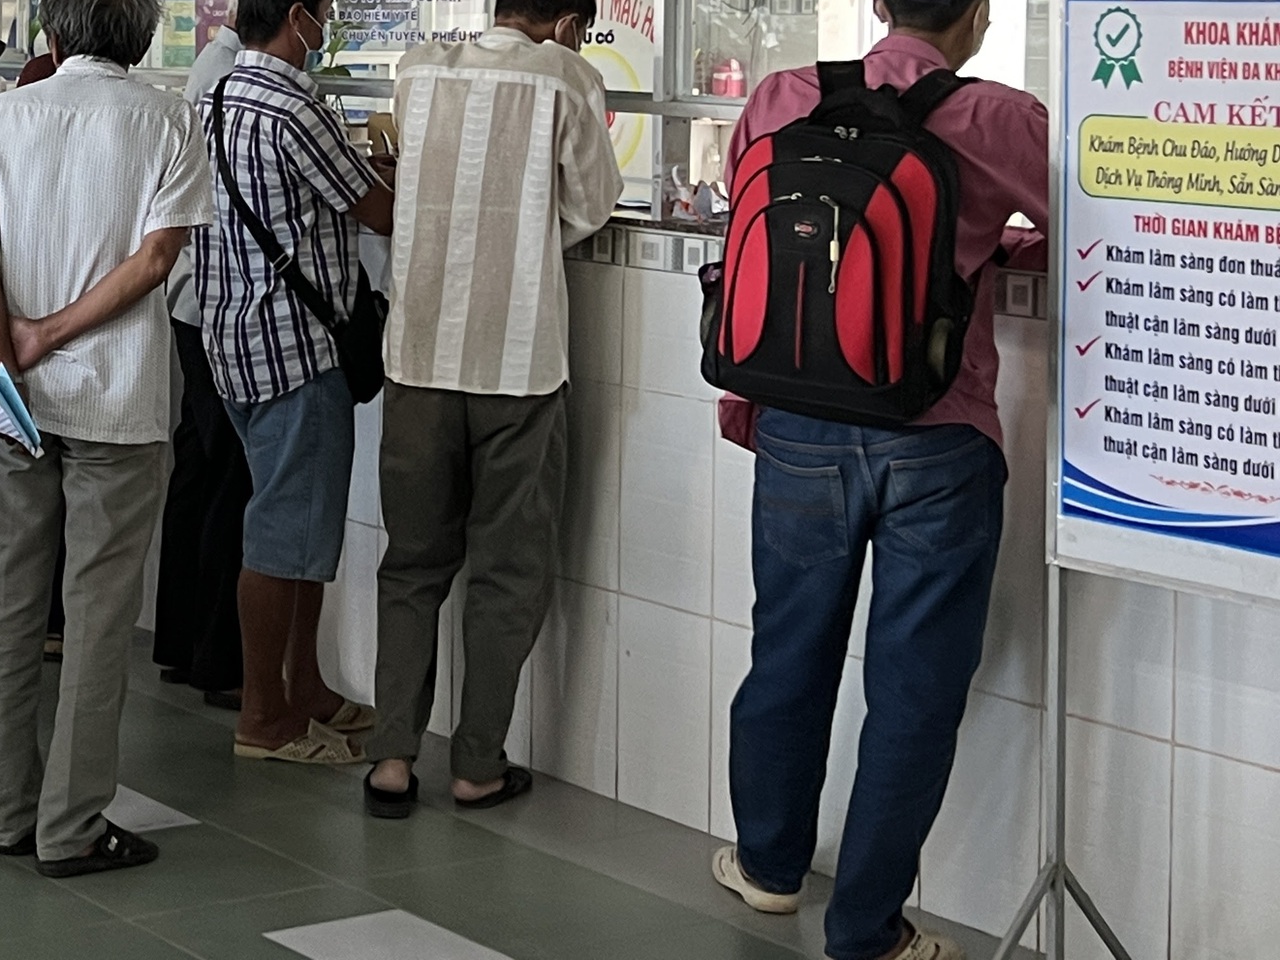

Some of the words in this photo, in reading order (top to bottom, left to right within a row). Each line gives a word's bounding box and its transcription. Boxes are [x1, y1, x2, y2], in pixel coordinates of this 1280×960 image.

[595, 29, 615, 44] CÓ
[1184, 21, 1230, 45] KHOA
[1168, 57, 1203, 82] BỆNH
[1208, 57, 1238, 84] VIỆN
[1153, 100, 1217, 125] CAM
[1226, 95, 1280, 128] KẾT
[1089, 134, 1124, 154] Khám
[1127, 136, 1158, 159] Bệnh
[1162, 138, 1187, 158] Chu
[1191, 140, 1220, 163] Đáo,
[1095, 166, 1122, 189] Dịch
[1126, 168, 1142, 191] Vụ
[1146, 170, 1183, 194] Thông
[1187, 172, 1223, 196] Minh,
[1133, 212, 1166, 235] THỜI
[1172, 218, 1208, 239] GIAN
[1213, 219, 1260, 243] KHÁM
[1106, 244, 1144, 265] Khám
[1150, 248, 1175, 268] lâm
[1180, 251, 1214, 274] sàng
[1219, 255, 1245, 275] đơn
[1105, 276, 1144, 297] Khám
[1149, 279, 1175, 301] lâm
[1179, 283, 1213, 307] sàng
[1218, 289, 1236, 307] có
[1241, 291, 1269, 311] làm
[1105, 310, 1139, 334] thuật
[1144, 314, 1169, 337] cận
[1173, 316, 1200, 338] lâm
[1205, 321, 1239, 345] sàng
[1105, 341, 1143, 363] Khám
[1148, 345, 1174, 367] lâm
[1179, 349, 1213, 374] sàng
[1218, 357, 1235, 376] có
[1240, 359, 1268, 380] làm
[1104, 375, 1139, 399] thuật
[1143, 380, 1169, 402] cận
[1172, 382, 1200, 405] lâm
[1204, 387, 1239, 412] sàng
[1104, 405, 1142, 426] Khám
[1147, 409, 1174, 432] lâm
[1178, 414, 1213, 440] sàng
[1217, 423, 1234, 442] có
[1240, 426, 1268, 447] làm
[1103, 435, 1138, 459] thuật
[1142, 440, 1167, 464] cận
[1171, 444, 1199, 467] lâm
[1203, 450, 1238, 475] sàng
